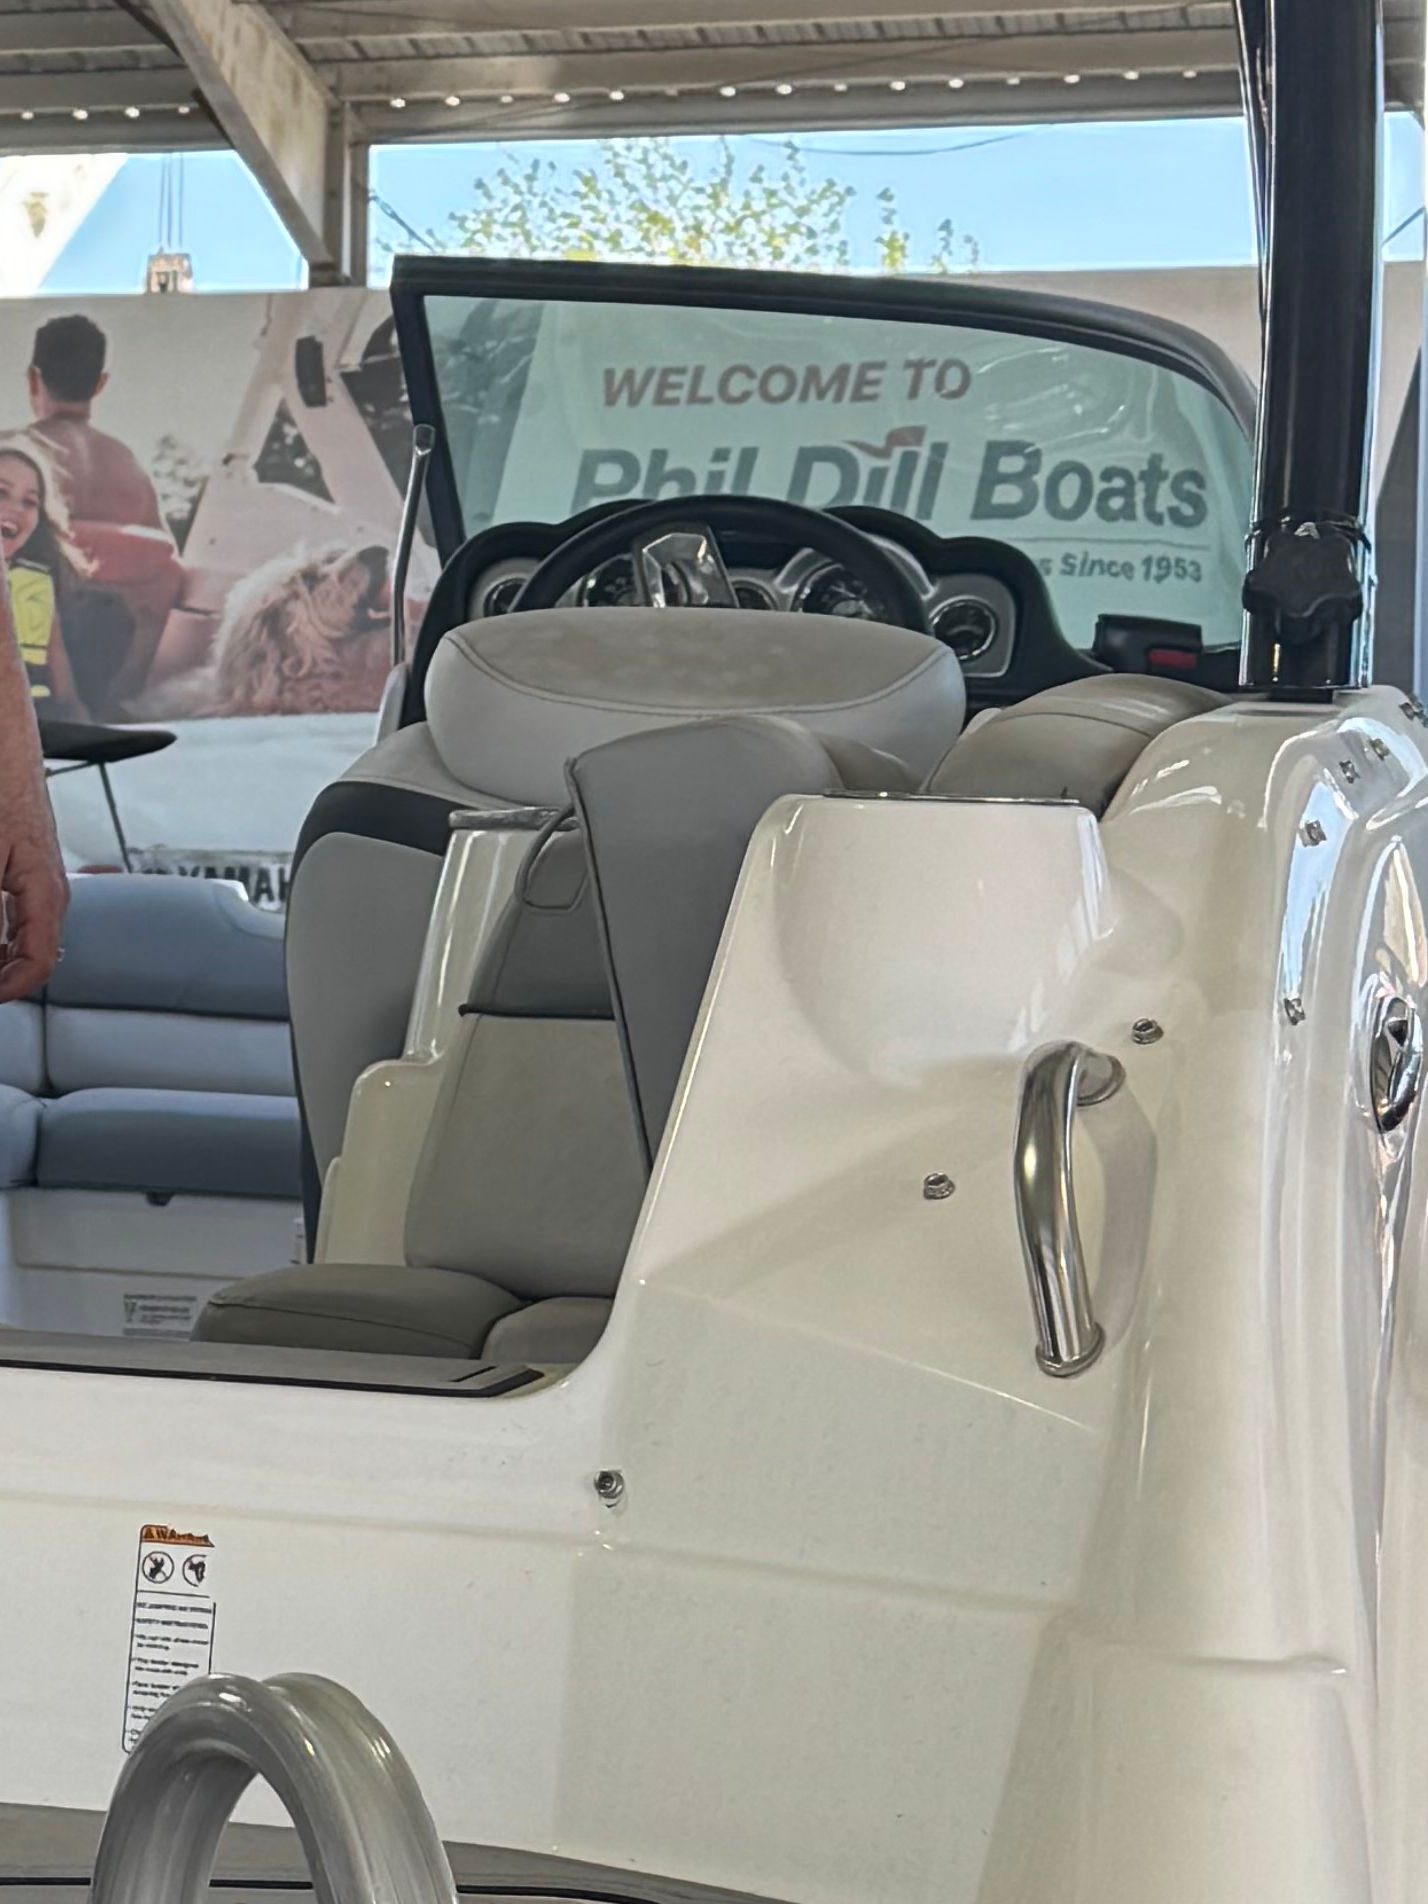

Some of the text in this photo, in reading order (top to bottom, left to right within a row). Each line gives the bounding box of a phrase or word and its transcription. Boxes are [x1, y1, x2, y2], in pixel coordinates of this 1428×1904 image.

[603, 357, 972, 408] WELCOME TO
[570, 427, 1207, 527] Phil Dill Boats
[1060, 550, 1135, 581] Since
[1141, 554, 1202, 583] 1953
